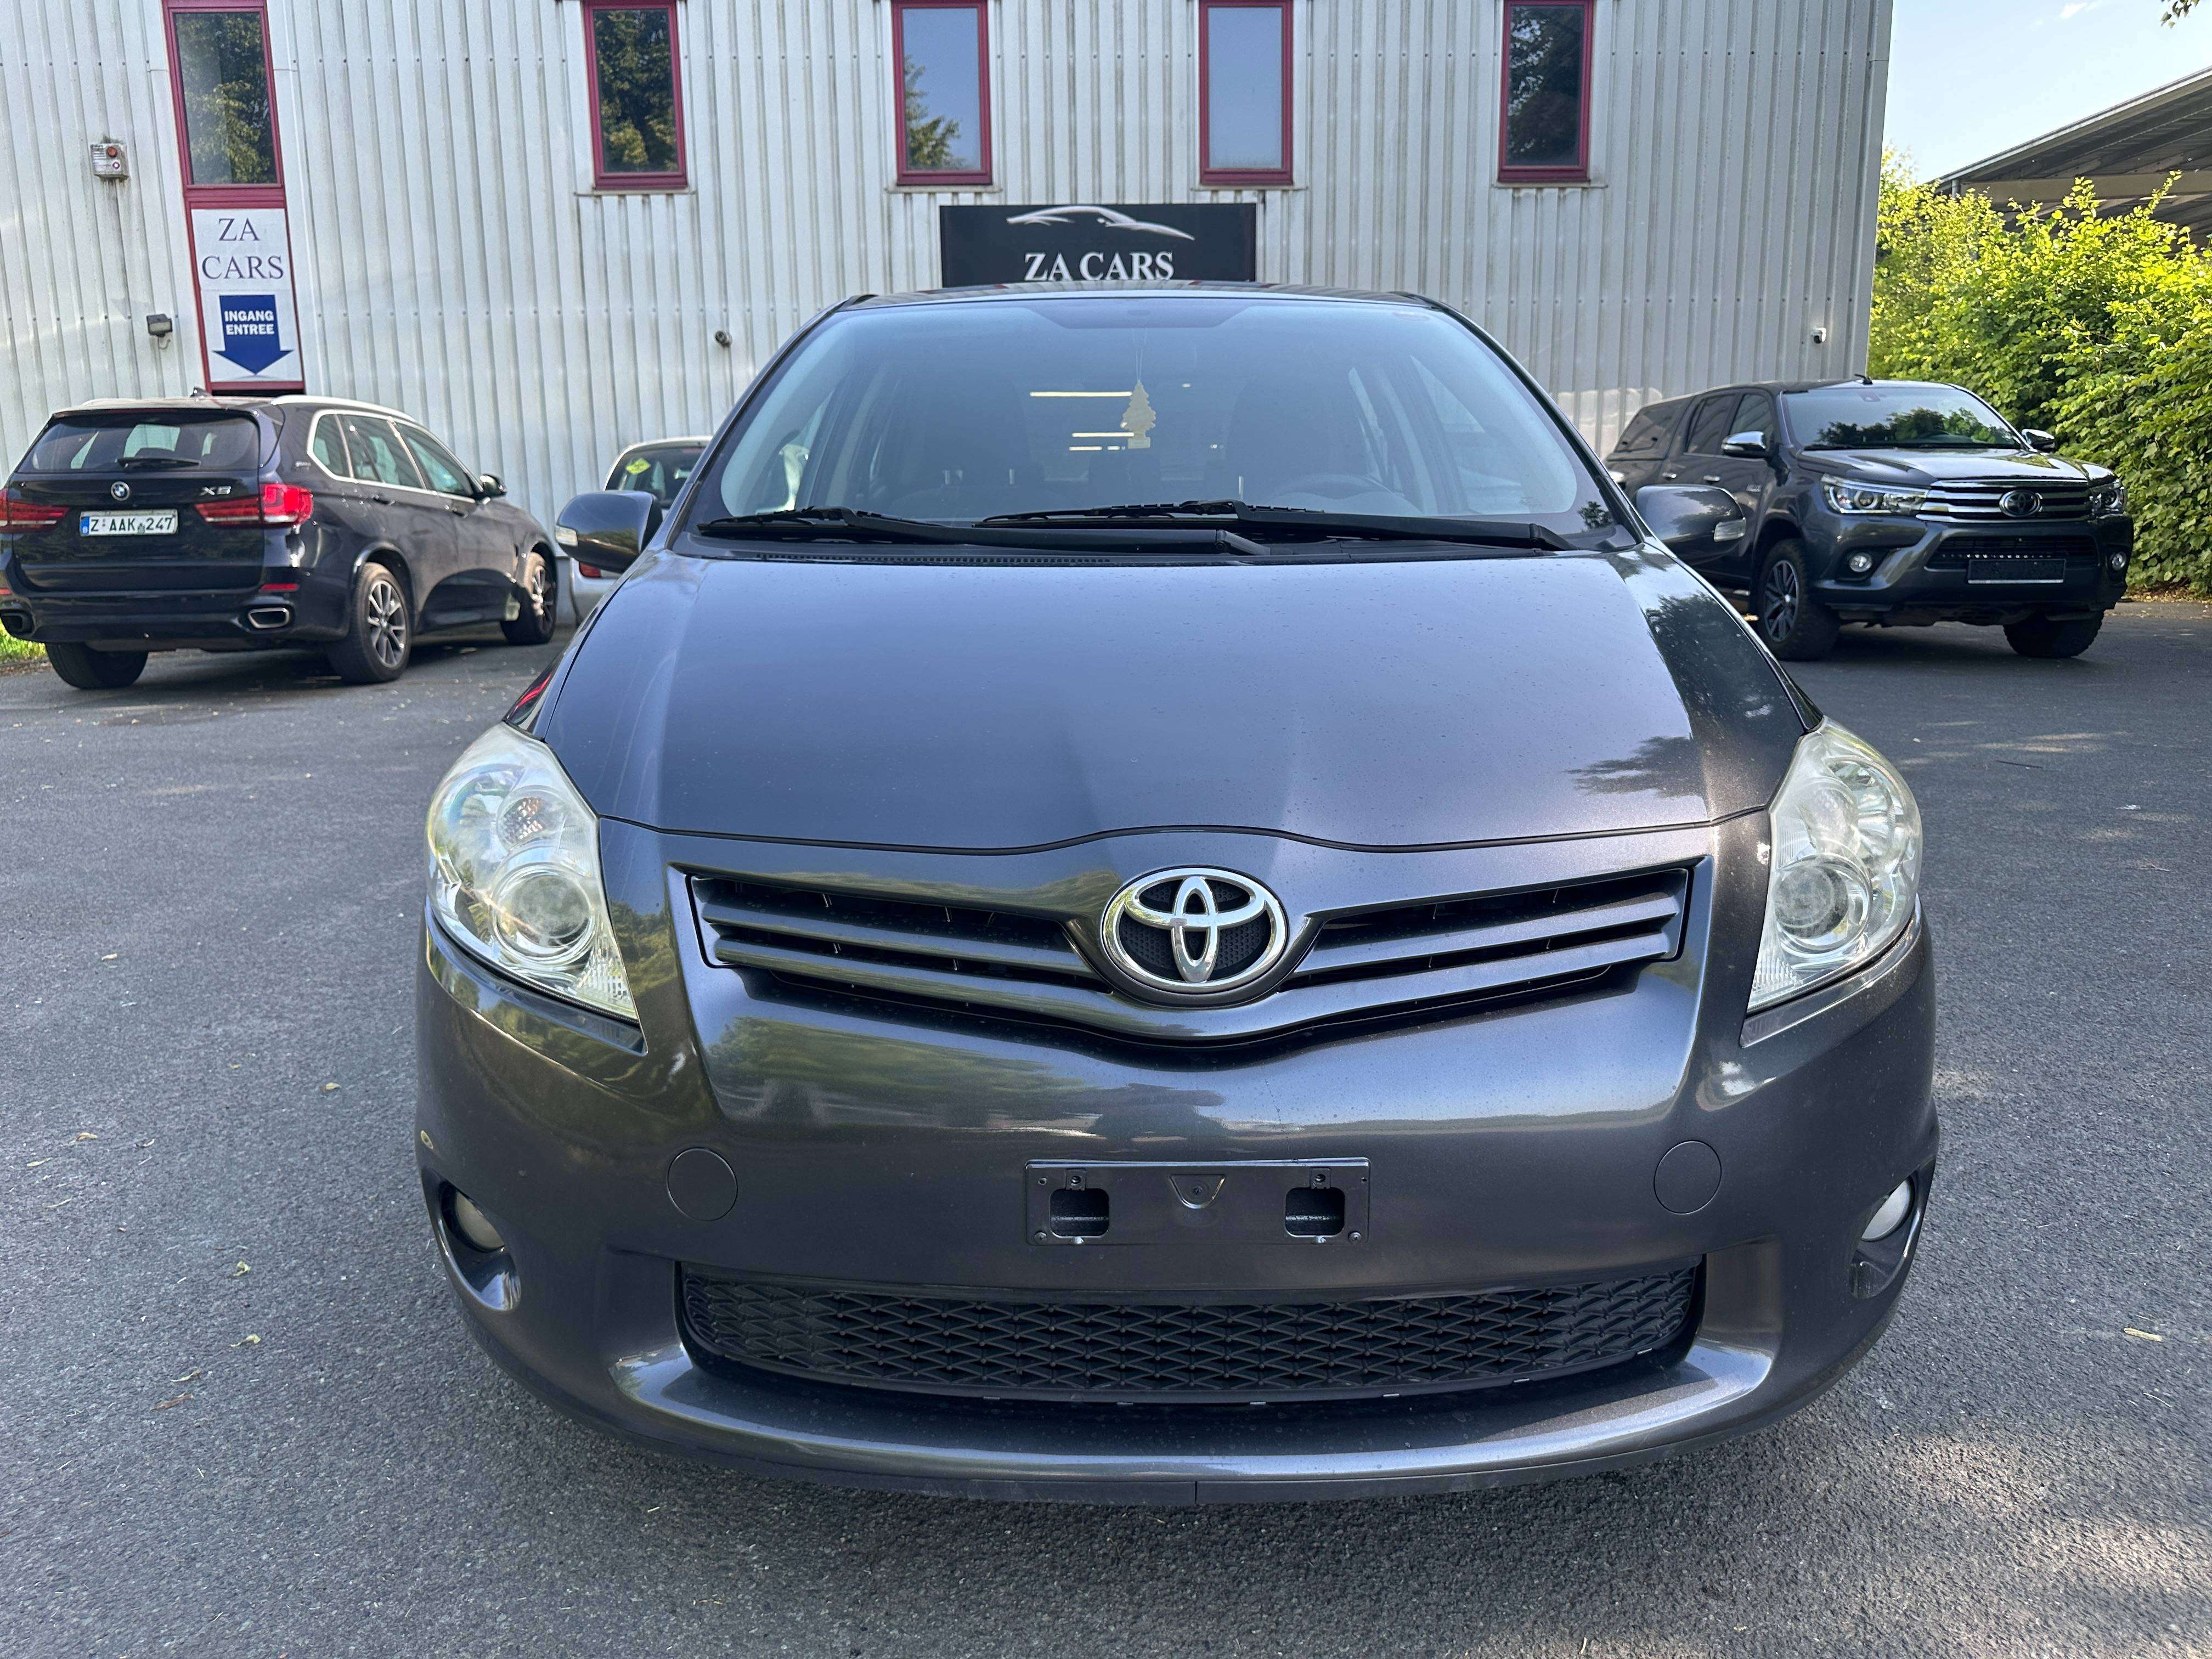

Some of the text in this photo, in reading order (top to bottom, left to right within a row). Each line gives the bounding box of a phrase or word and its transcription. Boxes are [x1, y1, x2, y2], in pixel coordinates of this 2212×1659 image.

[218, 217, 260, 241] ZA
[202, 255, 284, 280] CARS
[1024, 251, 1175, 281] ZA CARS
[224, 310, 274, 322] INGANG
[226, 323, 275, 335] ENTREE
